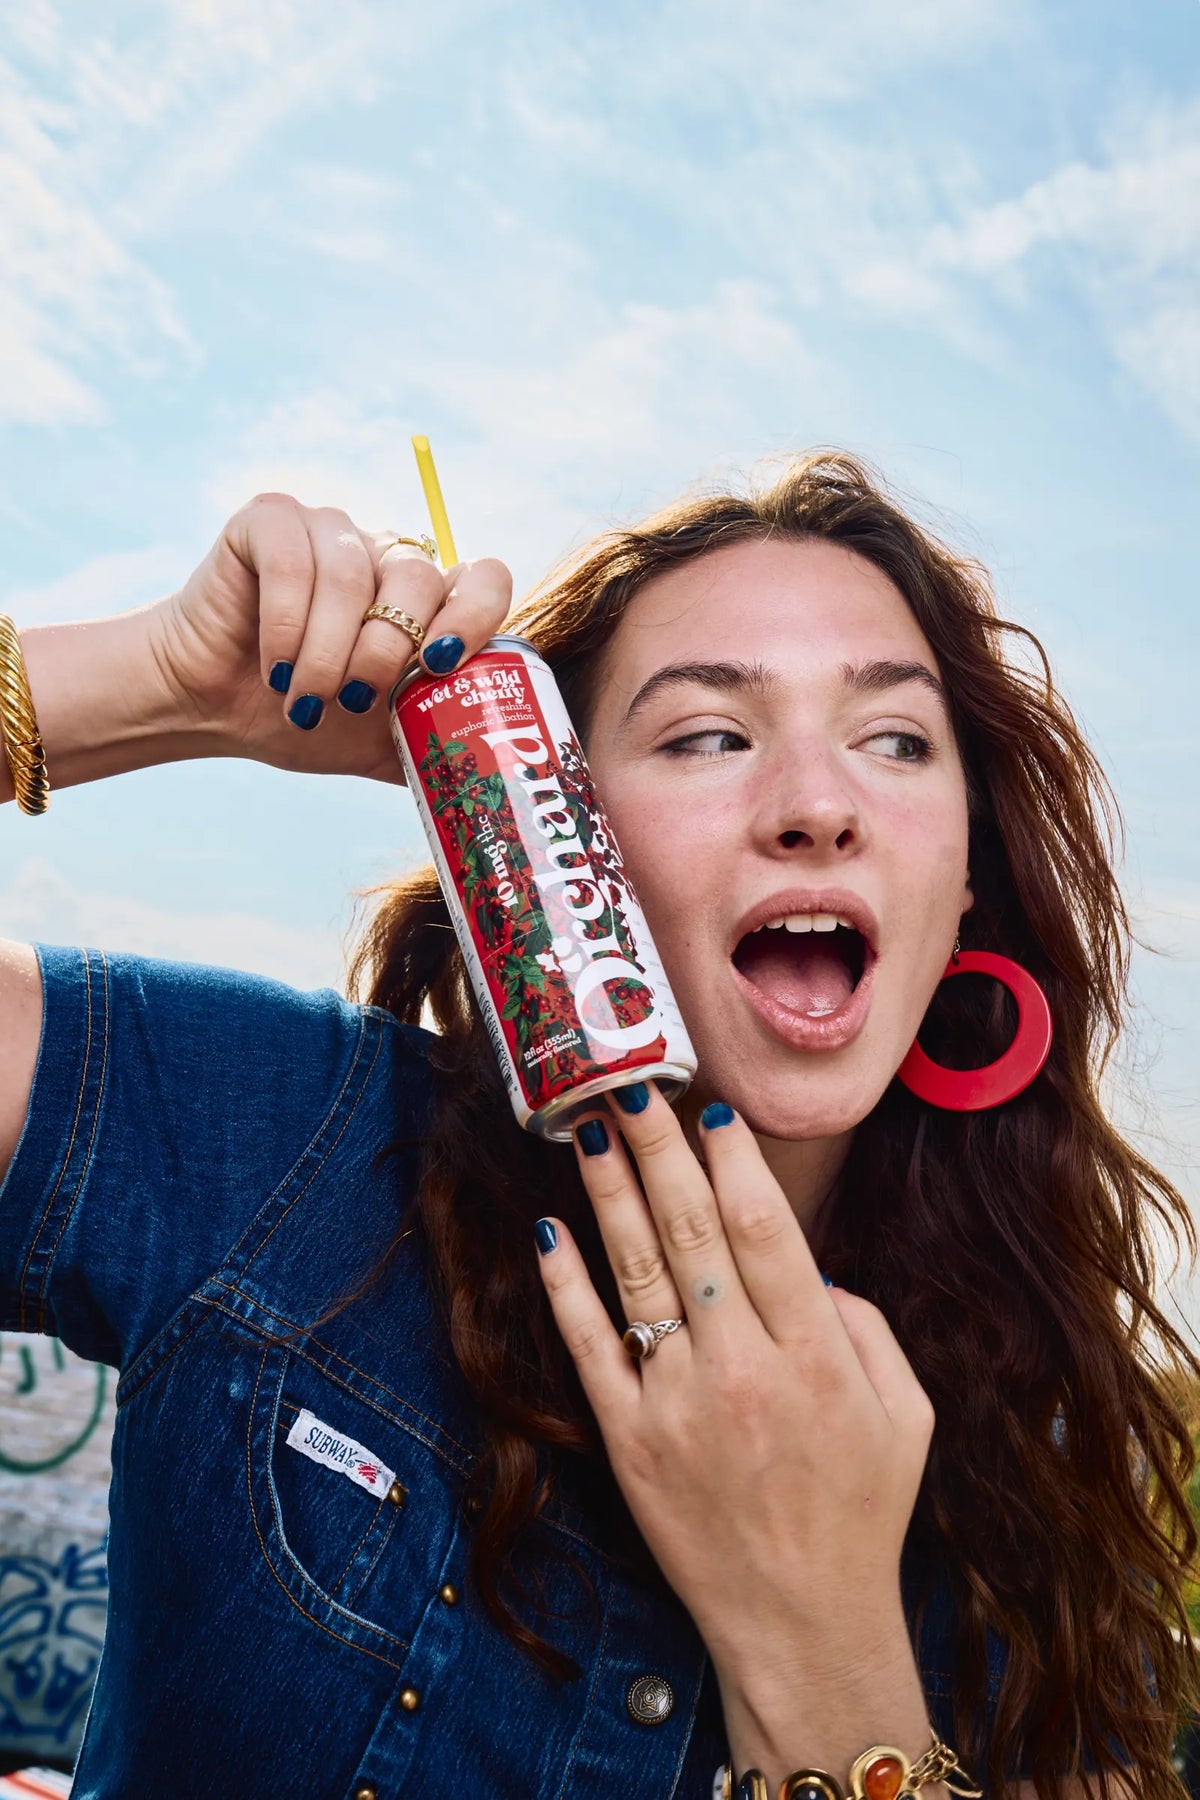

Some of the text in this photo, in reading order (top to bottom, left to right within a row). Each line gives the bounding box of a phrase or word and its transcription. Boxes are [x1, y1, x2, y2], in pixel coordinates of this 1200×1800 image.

[417, 684, 453, 713] wet
[454, 678, 471, 694] &
[472, 669, 523, 688] wild
[461, 684, 525, 707] cherry
[481, 701, 532, 715] refreshing
[451, 712, 536, 739] euphoric libation
[477, 814, 519, 908] 10 mg thc
[479, 722, 662, 1050] Orchard
[304, 1427, 357, 1464] SUBWAY
